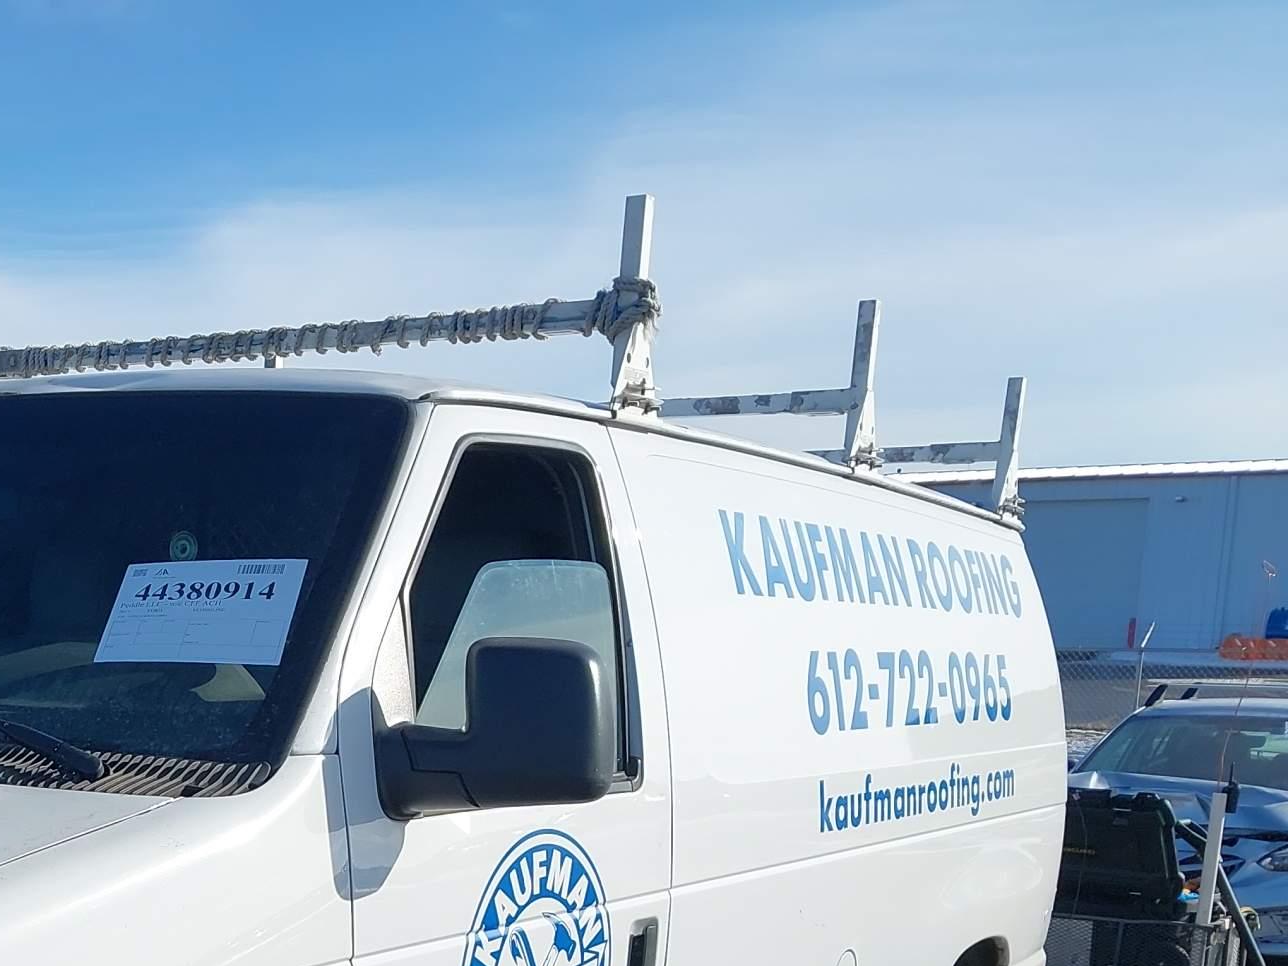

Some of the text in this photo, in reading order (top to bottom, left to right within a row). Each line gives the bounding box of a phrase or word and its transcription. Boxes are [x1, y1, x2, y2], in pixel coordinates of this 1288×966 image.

[134, 581, 277, 601] 44380914
[718, 509, 1022, 618] KAUFMAN ROOFING
[807, 648, 1012, 735] 612-722-0965
[818, 763, 1016, 833] kaufmanroofing.com
